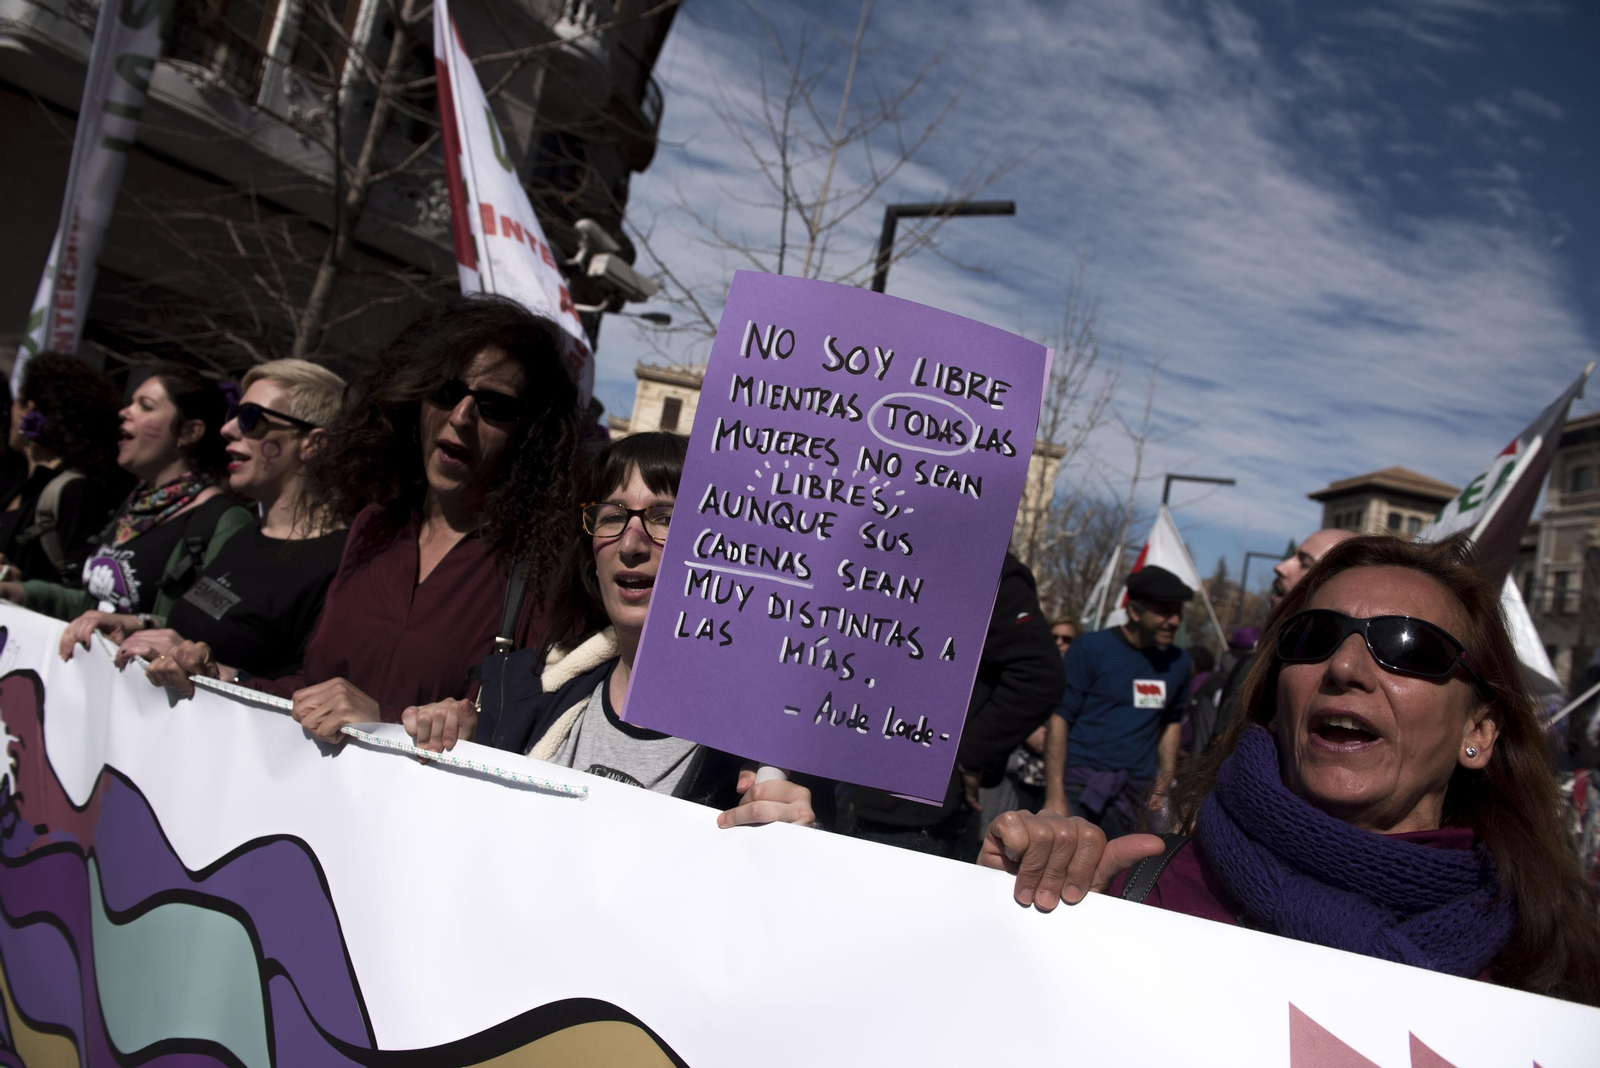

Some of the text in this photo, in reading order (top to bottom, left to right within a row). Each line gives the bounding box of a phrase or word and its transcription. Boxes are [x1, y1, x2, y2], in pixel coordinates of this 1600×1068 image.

[740, 319, 1013, 410] NO SOY LIBRE
[728, 372, 1017, 458] MIENTRAS TODAS LAS
[711, 416, 983, 500] MUJERES NO SEAN
[698, 482, 914, 557] AUNQUE SUS
[693, 527, 925, 604] CADENAS SEAN
[673, 610, 734, 648] LAS
[683, 568, 956, 662] MUY DISTINTAS A
